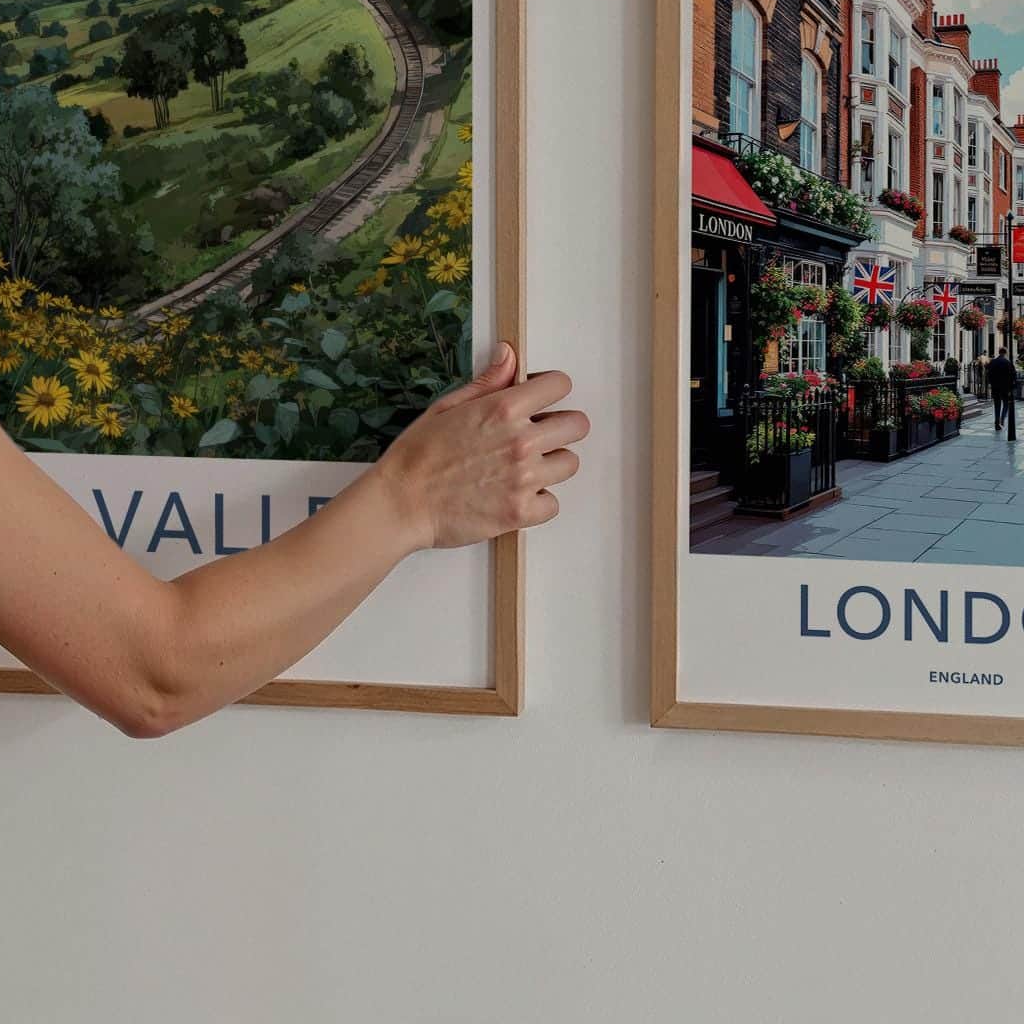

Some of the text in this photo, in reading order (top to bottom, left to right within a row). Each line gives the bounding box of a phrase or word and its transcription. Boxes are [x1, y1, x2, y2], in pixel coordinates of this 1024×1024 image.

[698, 213, 753, 242] LONDON
[800, 583, 1024, 645] LOND
[929, 670, 1004, 686] ENGLAND
